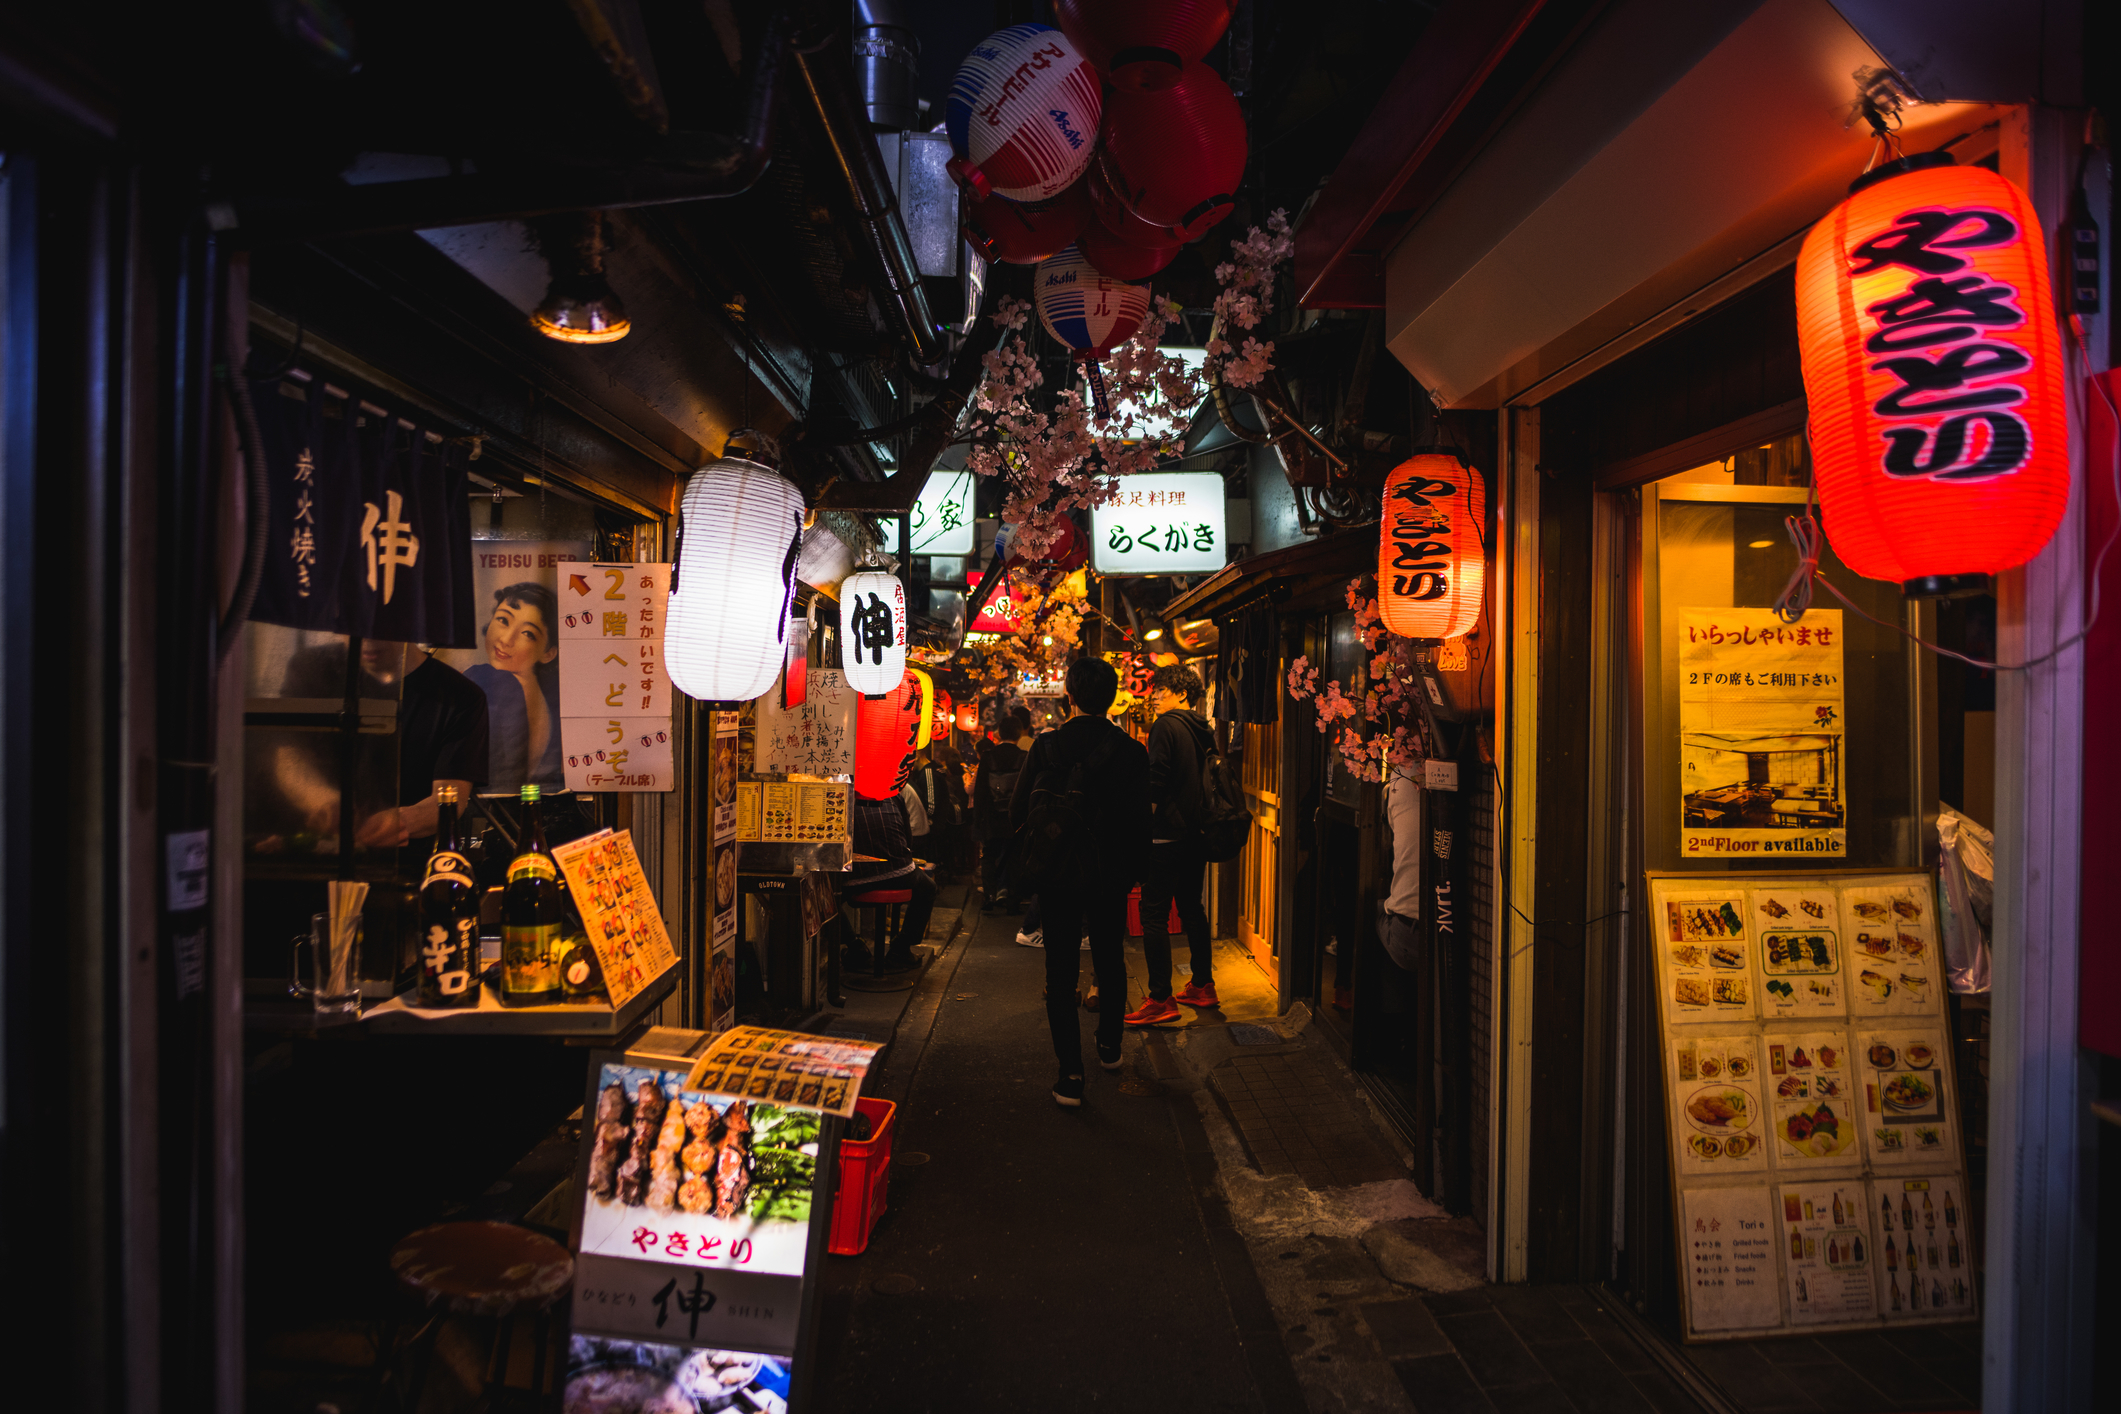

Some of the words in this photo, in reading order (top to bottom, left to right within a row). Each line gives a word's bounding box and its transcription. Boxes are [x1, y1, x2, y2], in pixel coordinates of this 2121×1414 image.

[979, 42, 1065, 127] アサヒビール
[1049, 109, 1084, 149] Asahi
[1045, 270, 1077, 287] Asahi
[1850, 207, 2032, 481] やきとり
[290, 446, 316, 598] 炭火焼き
[359, 488, 421, 606] 伸
[1108, 521, 1215, 553] らくがき
[1391, 476, 1458, 601] やきとり
[479, 554, 532, 568] YEBISU
[1688, 624, 1834, 646] いらっしゃいませ
[602, 568, 630, 775] 2階へどうぞ
[585, 773, 656, 787] (テーブル席)
[1688, 837, 1760, 853] 2ndFloor
[1764, 837, 1840, 853] available
[1738, 1220, 1757, 1230] Tori
[632, 1226, 753, 1265] やきとり
[1732, 1239, 1752, 1247] Grilled
[1735, 1265, 1756, 1273] Snacks
[1736, 1278, 1755, 1286] Drinks
[651, 1270, 718, 1342] 伸
[727, 1305, 775, 1320] SHIN
